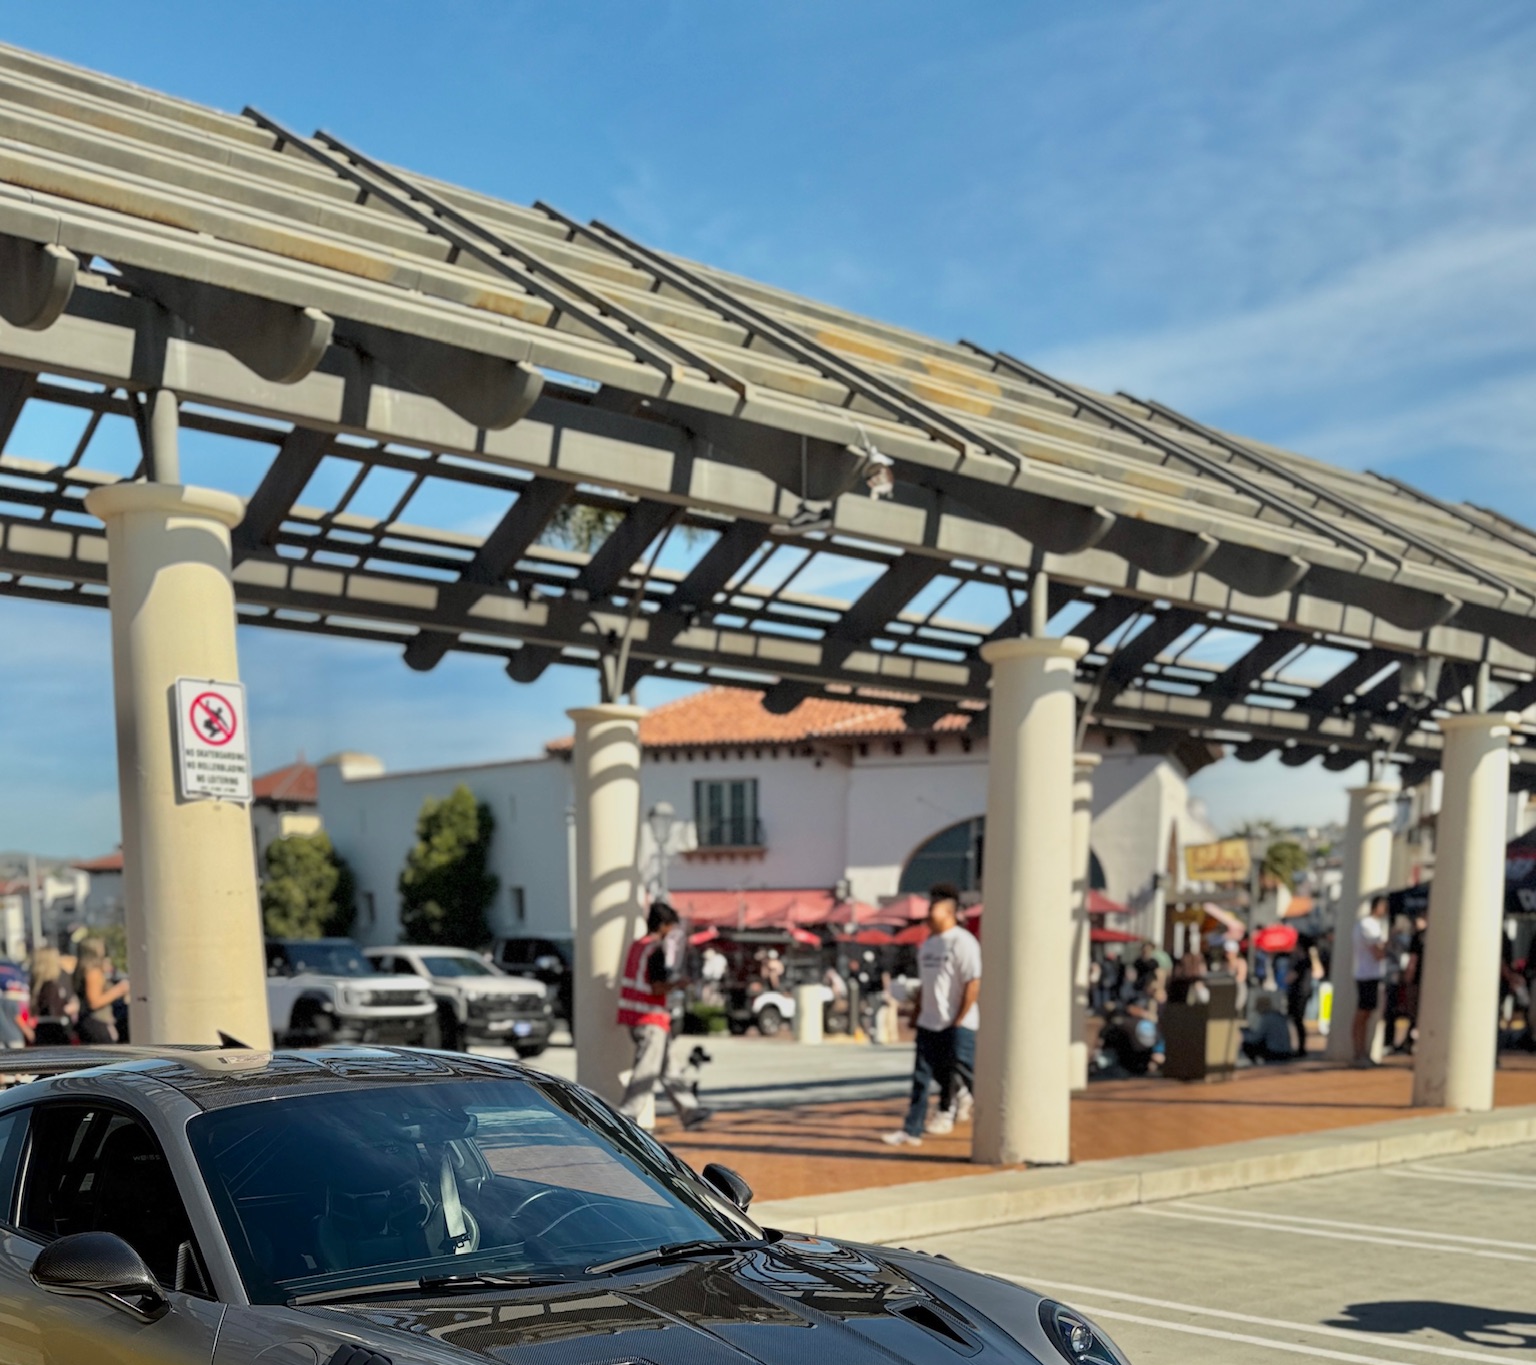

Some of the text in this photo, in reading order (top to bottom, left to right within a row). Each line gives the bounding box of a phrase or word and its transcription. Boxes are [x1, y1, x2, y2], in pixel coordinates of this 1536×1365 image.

[197, 749, 246, 760] SKATEBOARDING
[198, 762, 246, 773] ROLLERBLADING
[197, 774, 239, 785] NO LOITERING
